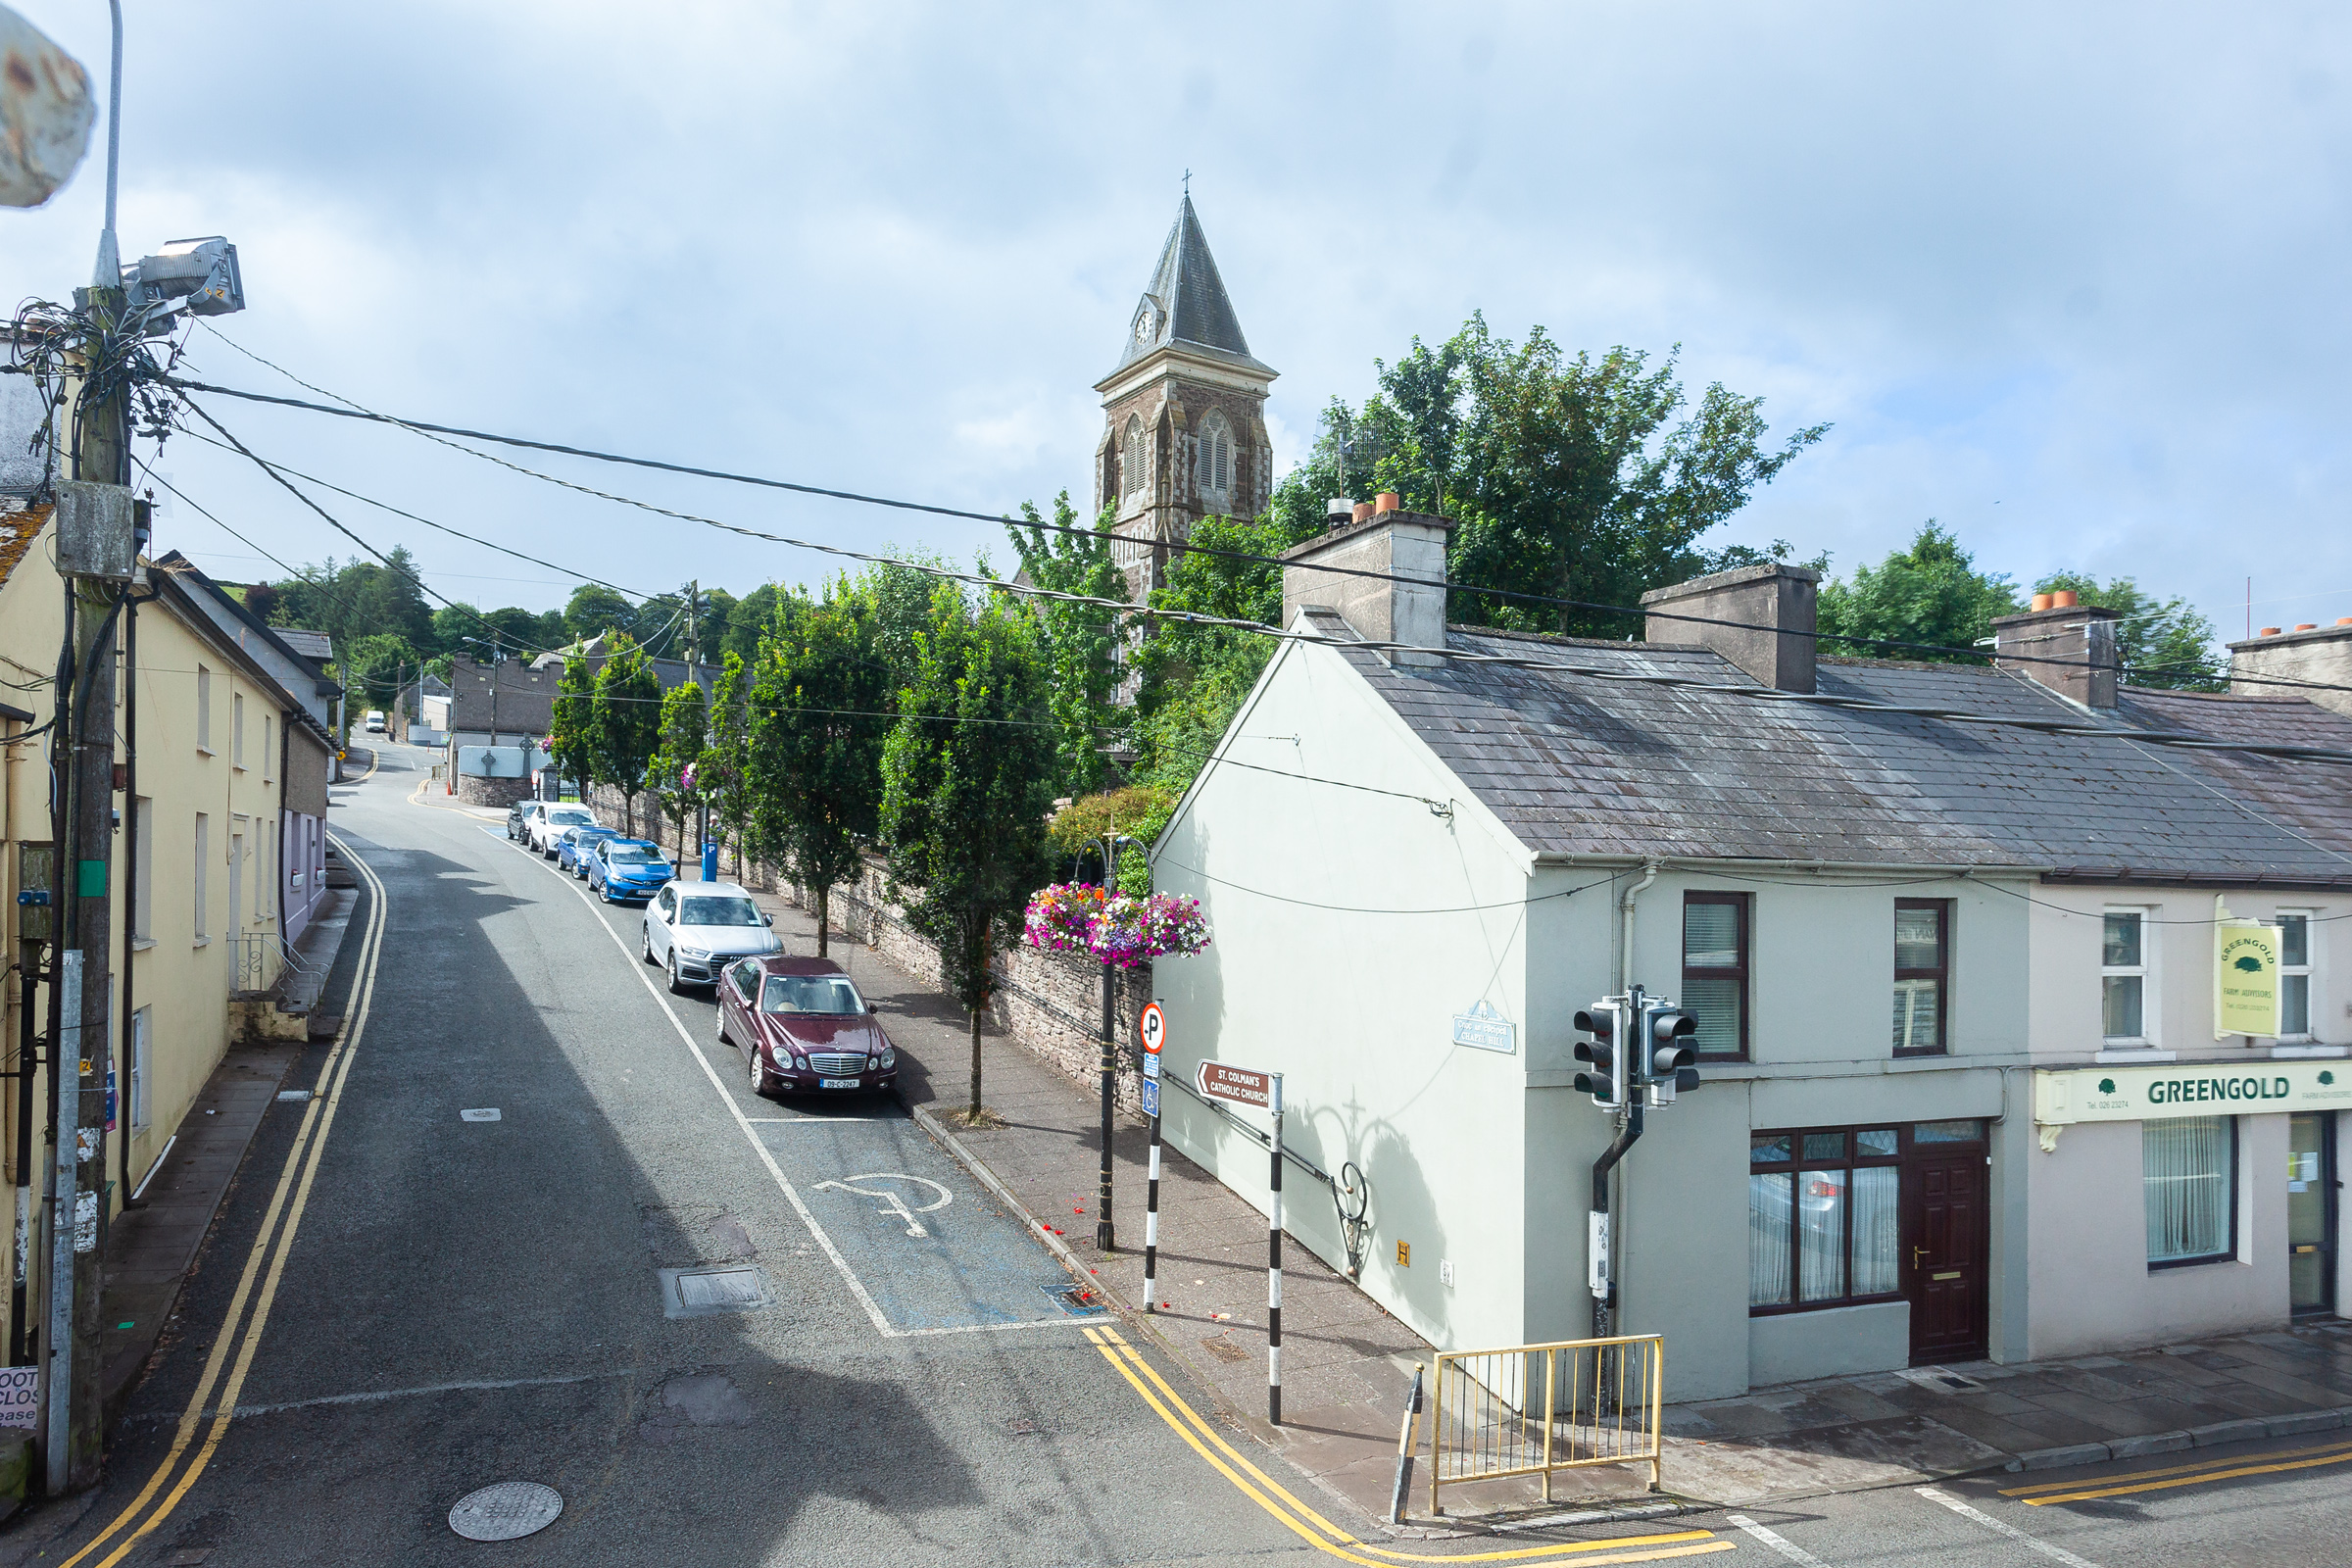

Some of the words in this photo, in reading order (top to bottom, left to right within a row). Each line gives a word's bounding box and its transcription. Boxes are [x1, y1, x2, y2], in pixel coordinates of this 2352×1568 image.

[2221, 938, 2275, 964] GREENGOLD
[1150, 1014, 1158, 1040] P
[1461, 1032, 1486, 1044] CHAPEL
[1489, 1036, 1504, 1047] HILL
[1218, 1069, 1227, 1080] ST.
[1228, 1071, 1260, 1087] COLMAN'S
[1210, 1081, 1241, 1097] CATHOLIC
[1241, 1088, 1268, 1103] CHURCH
[2148, 1077, 2290, 1104] GREENGOLD
[2099, 1101, 2111, 1109] 026
[2111, 1100, 2129, 1108] 23274
[1398, 1243, 1408, 1264] H
